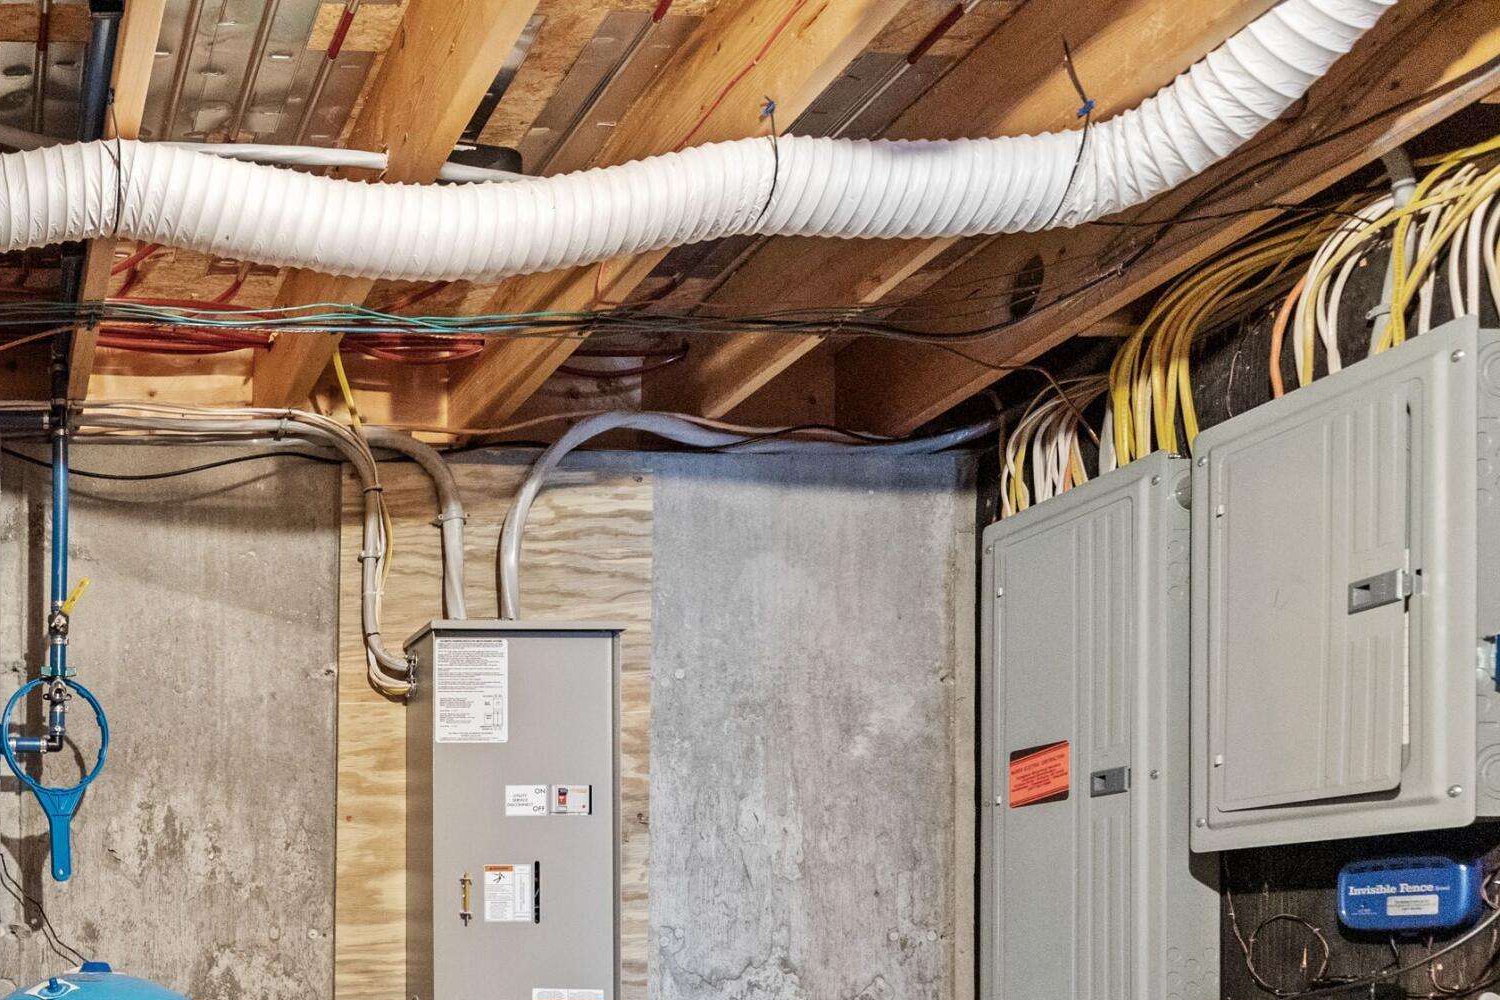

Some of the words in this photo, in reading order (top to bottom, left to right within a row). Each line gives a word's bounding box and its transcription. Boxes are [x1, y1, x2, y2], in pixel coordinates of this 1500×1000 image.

[534, 787, 546, 795] ON
[1348, 884, 1397, 896] Invisible
[1398, 883, 1434, 893] Fence
